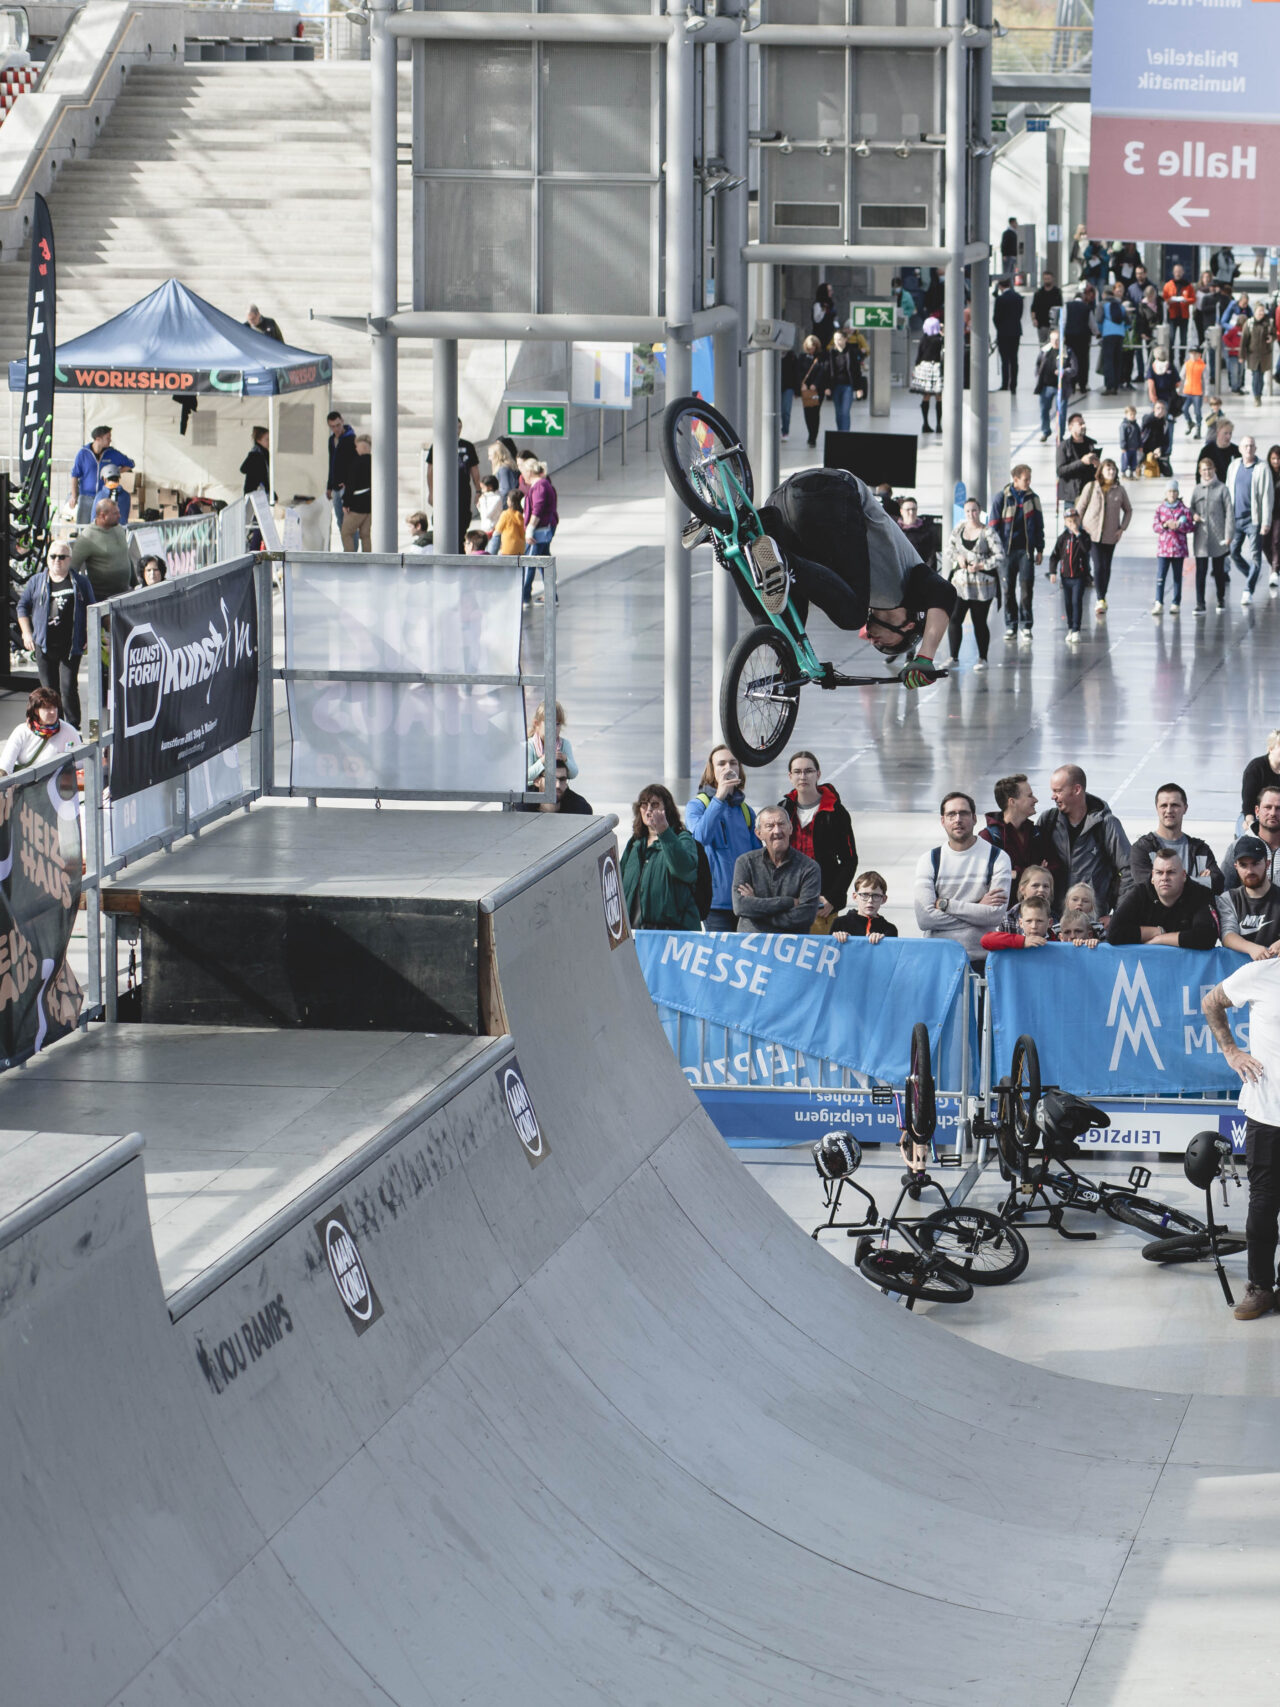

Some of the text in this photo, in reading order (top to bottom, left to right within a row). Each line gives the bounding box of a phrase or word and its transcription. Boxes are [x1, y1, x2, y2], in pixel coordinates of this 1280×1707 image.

[75, 368, 194, 390] WORKSHOP
[129, 643, 160, 666] KUNST
[128, 661, 161, 688] FORM
[20, 802, 65, 868] HEIZ
[21, 840, 72, 909] HAUS
[1242, 914, 1266, 928] NIKE
[660, 935, 773, 997] MESSE
[507, 1081, 529, 1117] MAN
[516, 1106, 538, 1143] KIND
[795, 1111, 873, 1127] Leipzigern
[330, 1234, 357, 1277] MAN
[340, 1264, 367, 1306] KIND
[241, 1293, 294, 1363] RAMPS
